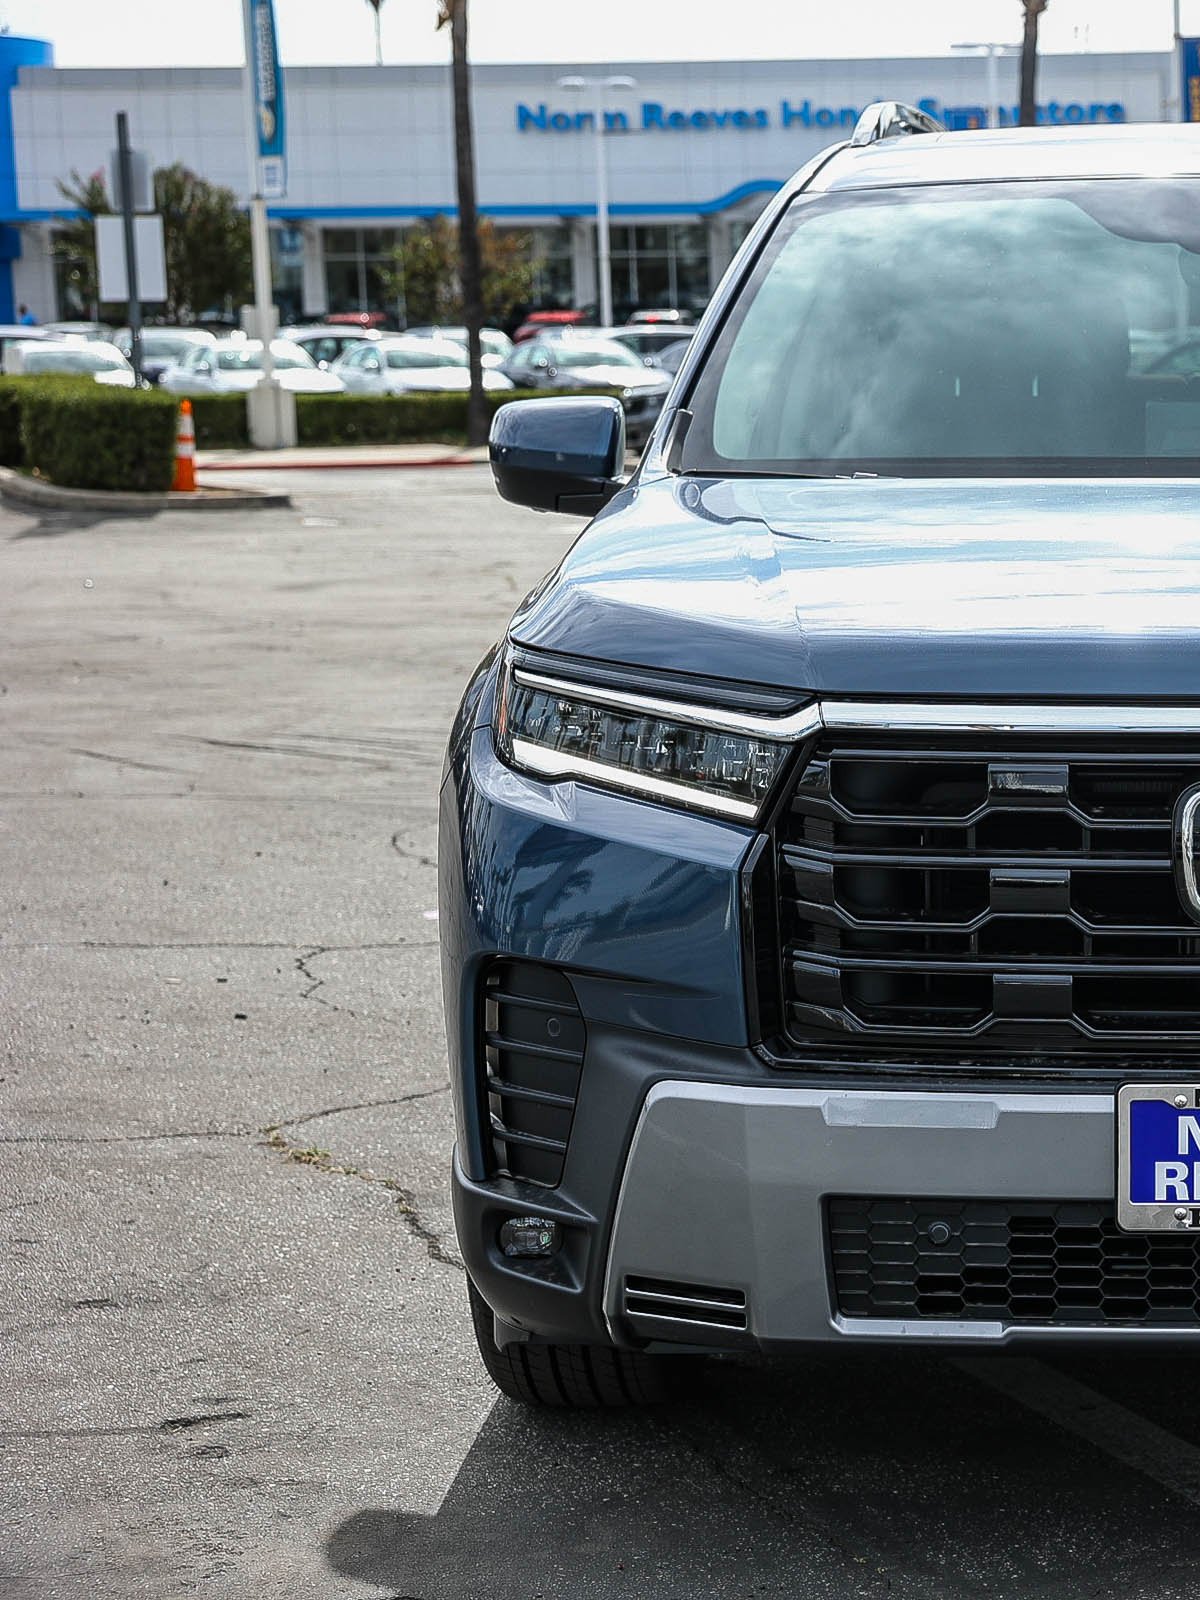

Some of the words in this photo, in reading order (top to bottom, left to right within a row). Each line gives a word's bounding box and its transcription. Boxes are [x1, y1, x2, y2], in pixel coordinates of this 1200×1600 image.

[515, 103, 628, 131] Norm
[641, 102, 769, 130] Reeves
[780, 98, 882, 128] Hon
